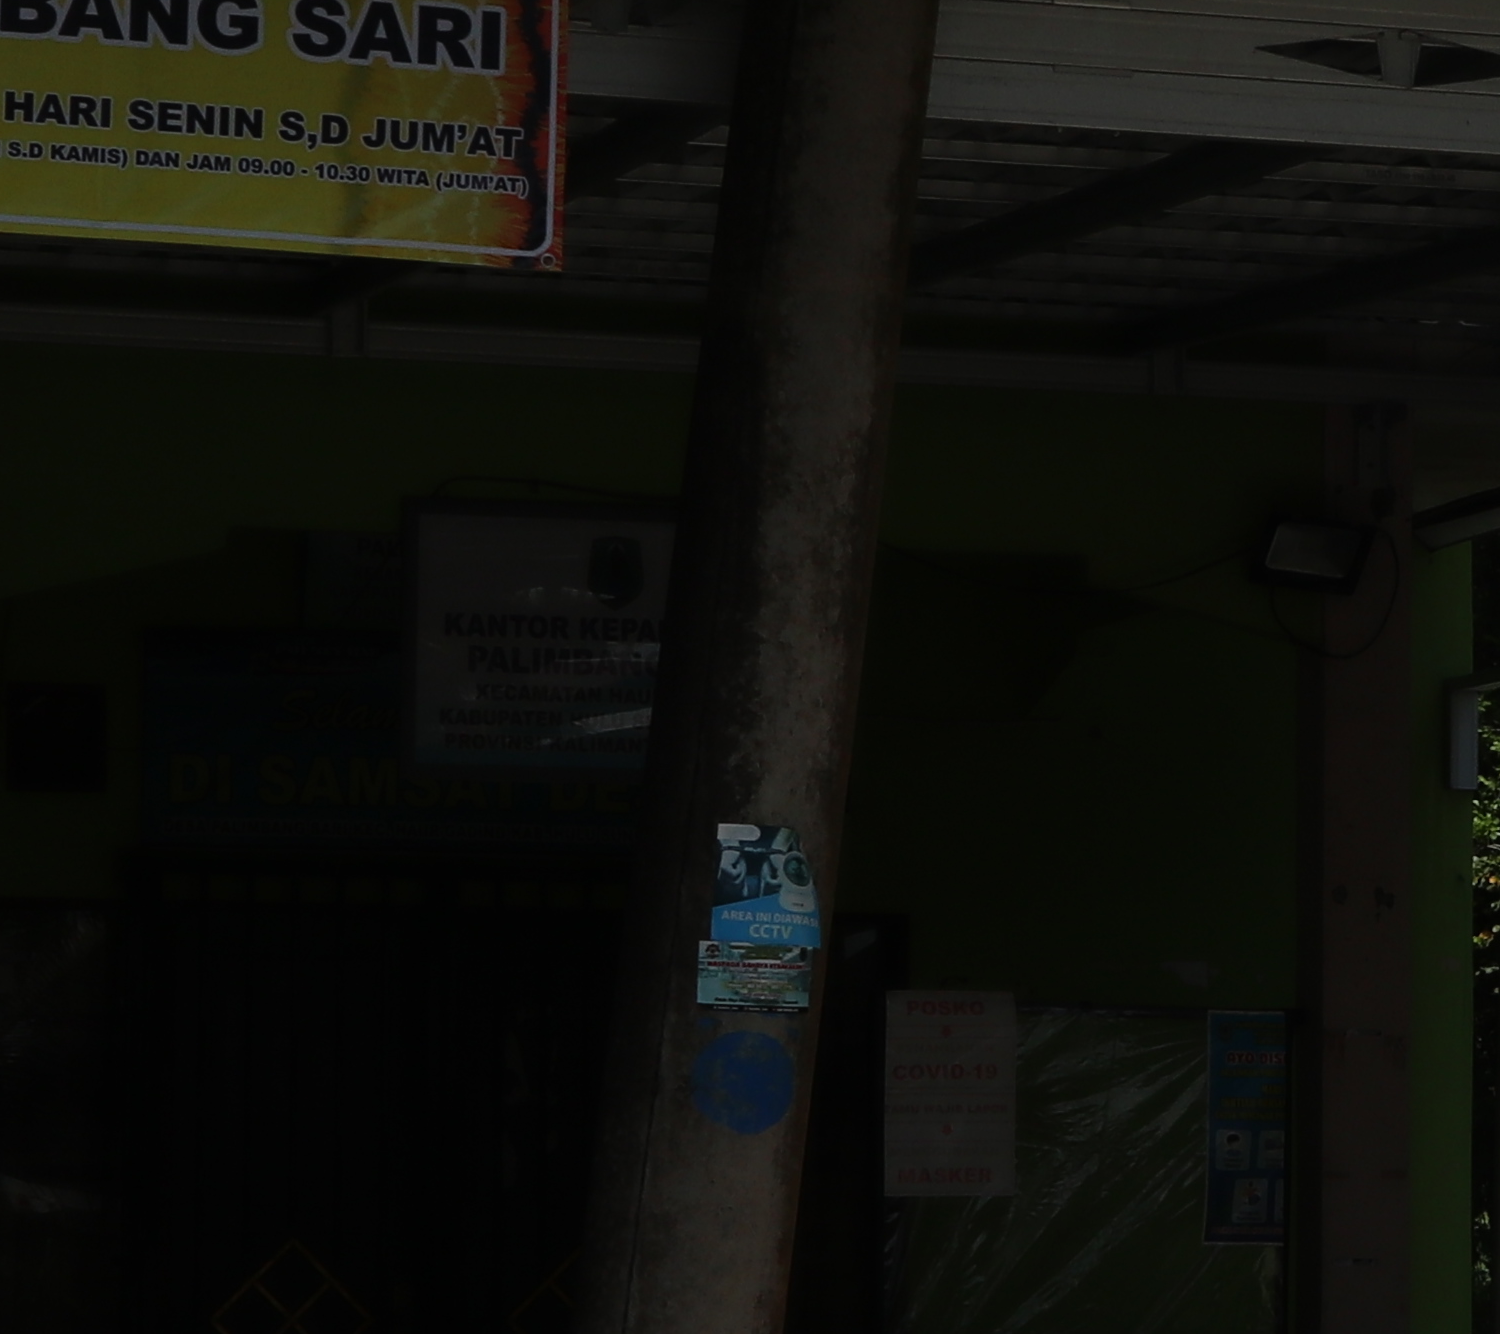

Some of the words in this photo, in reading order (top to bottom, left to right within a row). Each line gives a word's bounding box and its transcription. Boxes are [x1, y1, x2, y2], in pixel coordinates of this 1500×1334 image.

[5, 91, 110, 127] HARI
[128, 100, 263, 138] SENIN
[280, 112, 349, 150] S,D
[363, 118, 522, 157] JUM'AT
[7, 142, 43, 160] S.D
[49, 146, 127, 167] KAMIS)
[136, 150, 180, 168] DAN
[186, 154, 231, 172] JAM
[238, 157, 295, 176] 09.00
[315, 164, 370, 183] 10.30
[377, 168, 429, 187] WITA
[444, 613, 569, 639] KANTOR
[476, 683, 603, 703] KECAMATAN
[440, 708, 562, 726] KABUPATEN
[170, 754, 231, 803] DI
[210, 818, 306, 835] PALIMBANG
[721, 909, 754, 923] AREA
[756, 911, 772, 924] INI
[749, 923, 793, 940] CCTV
[906, 999, 985, 1015] POSKO
[892, 1061, 999, 1080] COVID-19
[923, 1102, 964, 1114] WAJIB
[897, 1166, 993, 1183] MASKER
